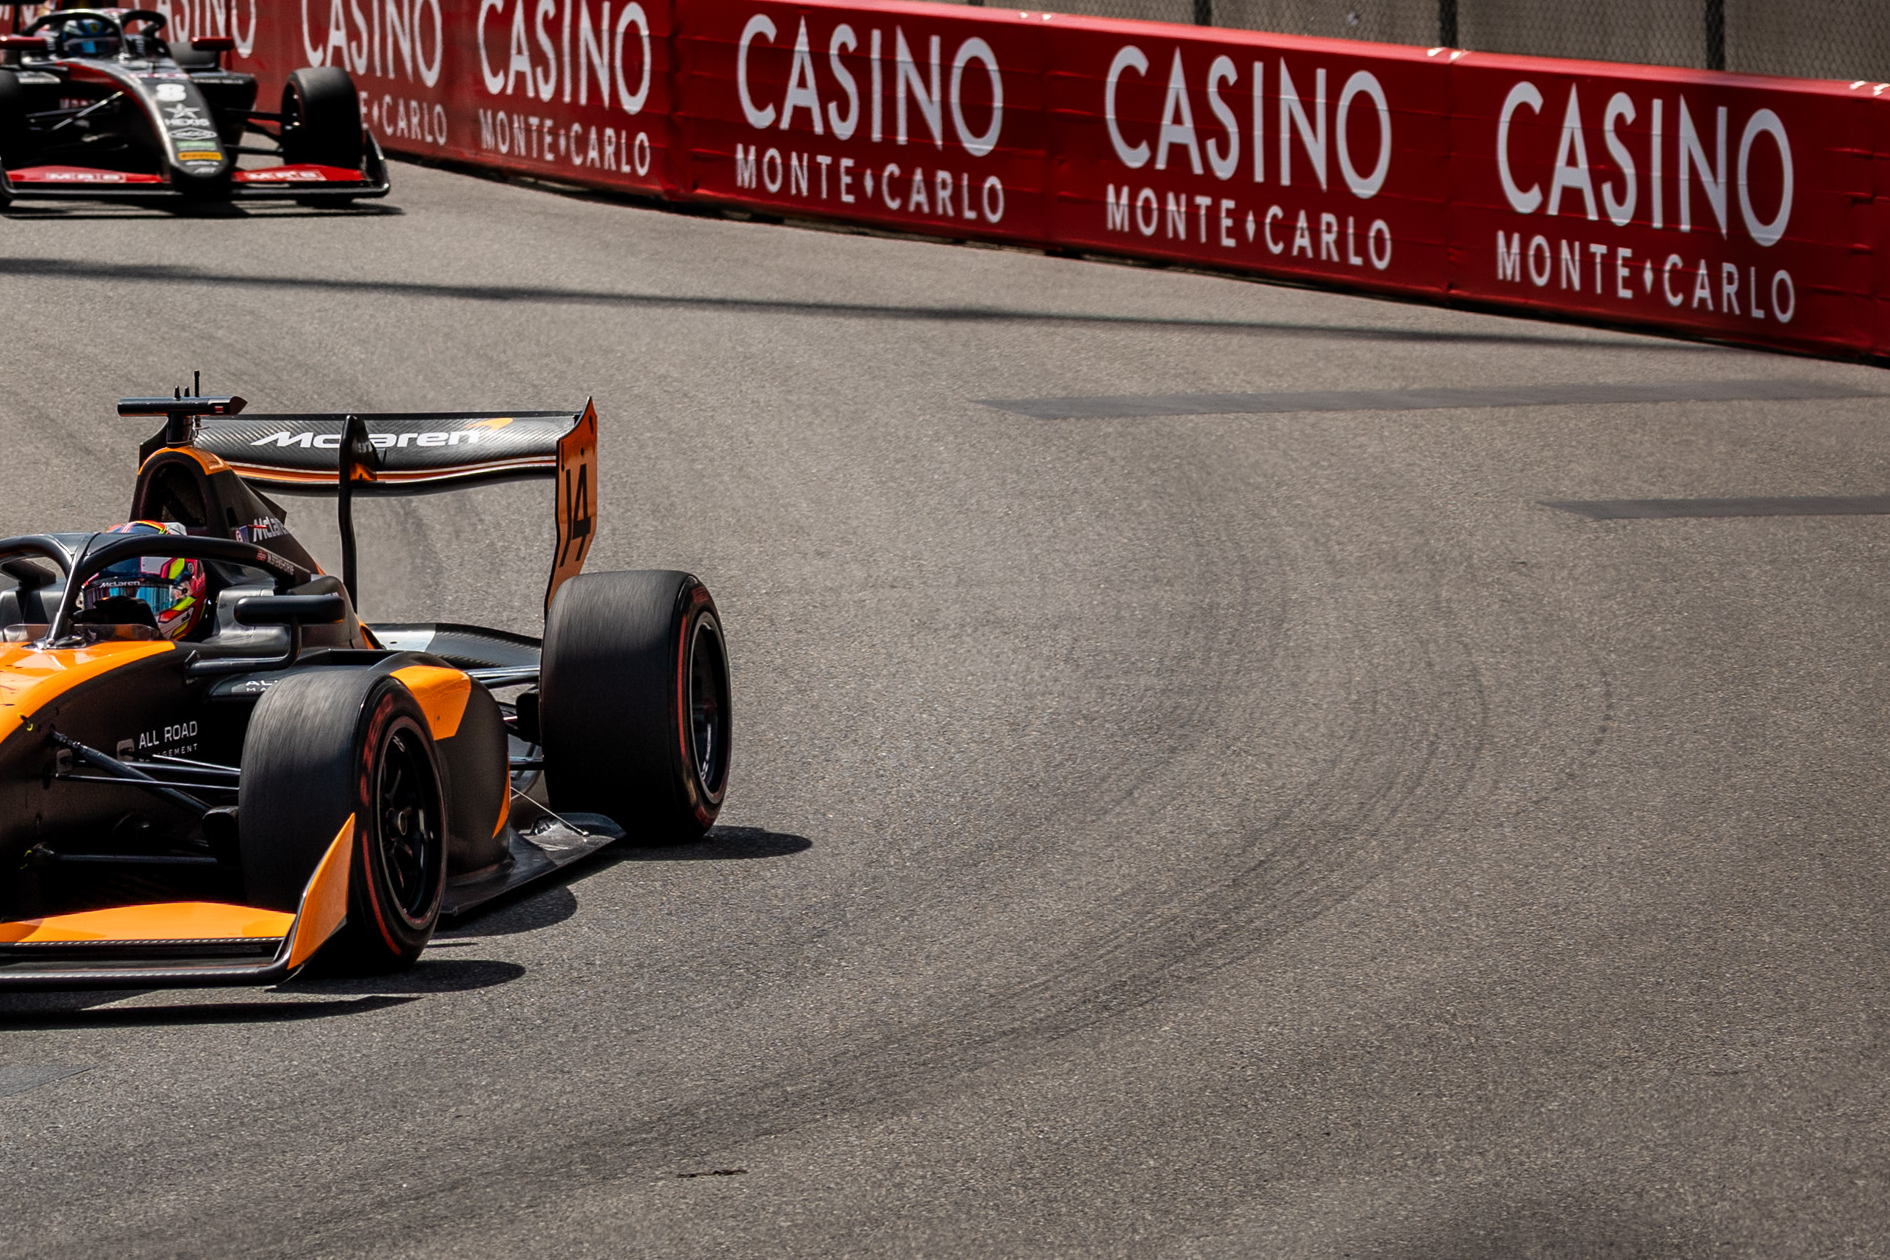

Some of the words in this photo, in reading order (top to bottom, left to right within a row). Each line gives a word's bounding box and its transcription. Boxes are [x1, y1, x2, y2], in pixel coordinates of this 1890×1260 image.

[155, 83, 187, 102] 8
[382, 96, 448, 146] CARLO
[736, 13, 1004, 157] CASINO
[1104, 45, 1393, 200] CASINO
[480, 108, 554, 164] MONTE
[569, 123, 652, 179] CARLO
[735, 143, 857, 205] MONTE
[882, 162, 1006, 225] CARLO
[1496, 80, 1795, 249] CASINO
[1106, 182, 1237, 249] MONTE
[1265, 204, 1393, 272] CARLO
[1496, 230, 1634, 301] MONTE
[1661, 252, 1797, 325] CARLO
[251, 429, 481, 449] Mcaren
[560, 463, 591, 568] 14
[99, 581, 141, 589] McLaren
[138, 731, 160, 750] ALL
[163, 720, 199, 743] ROAD
